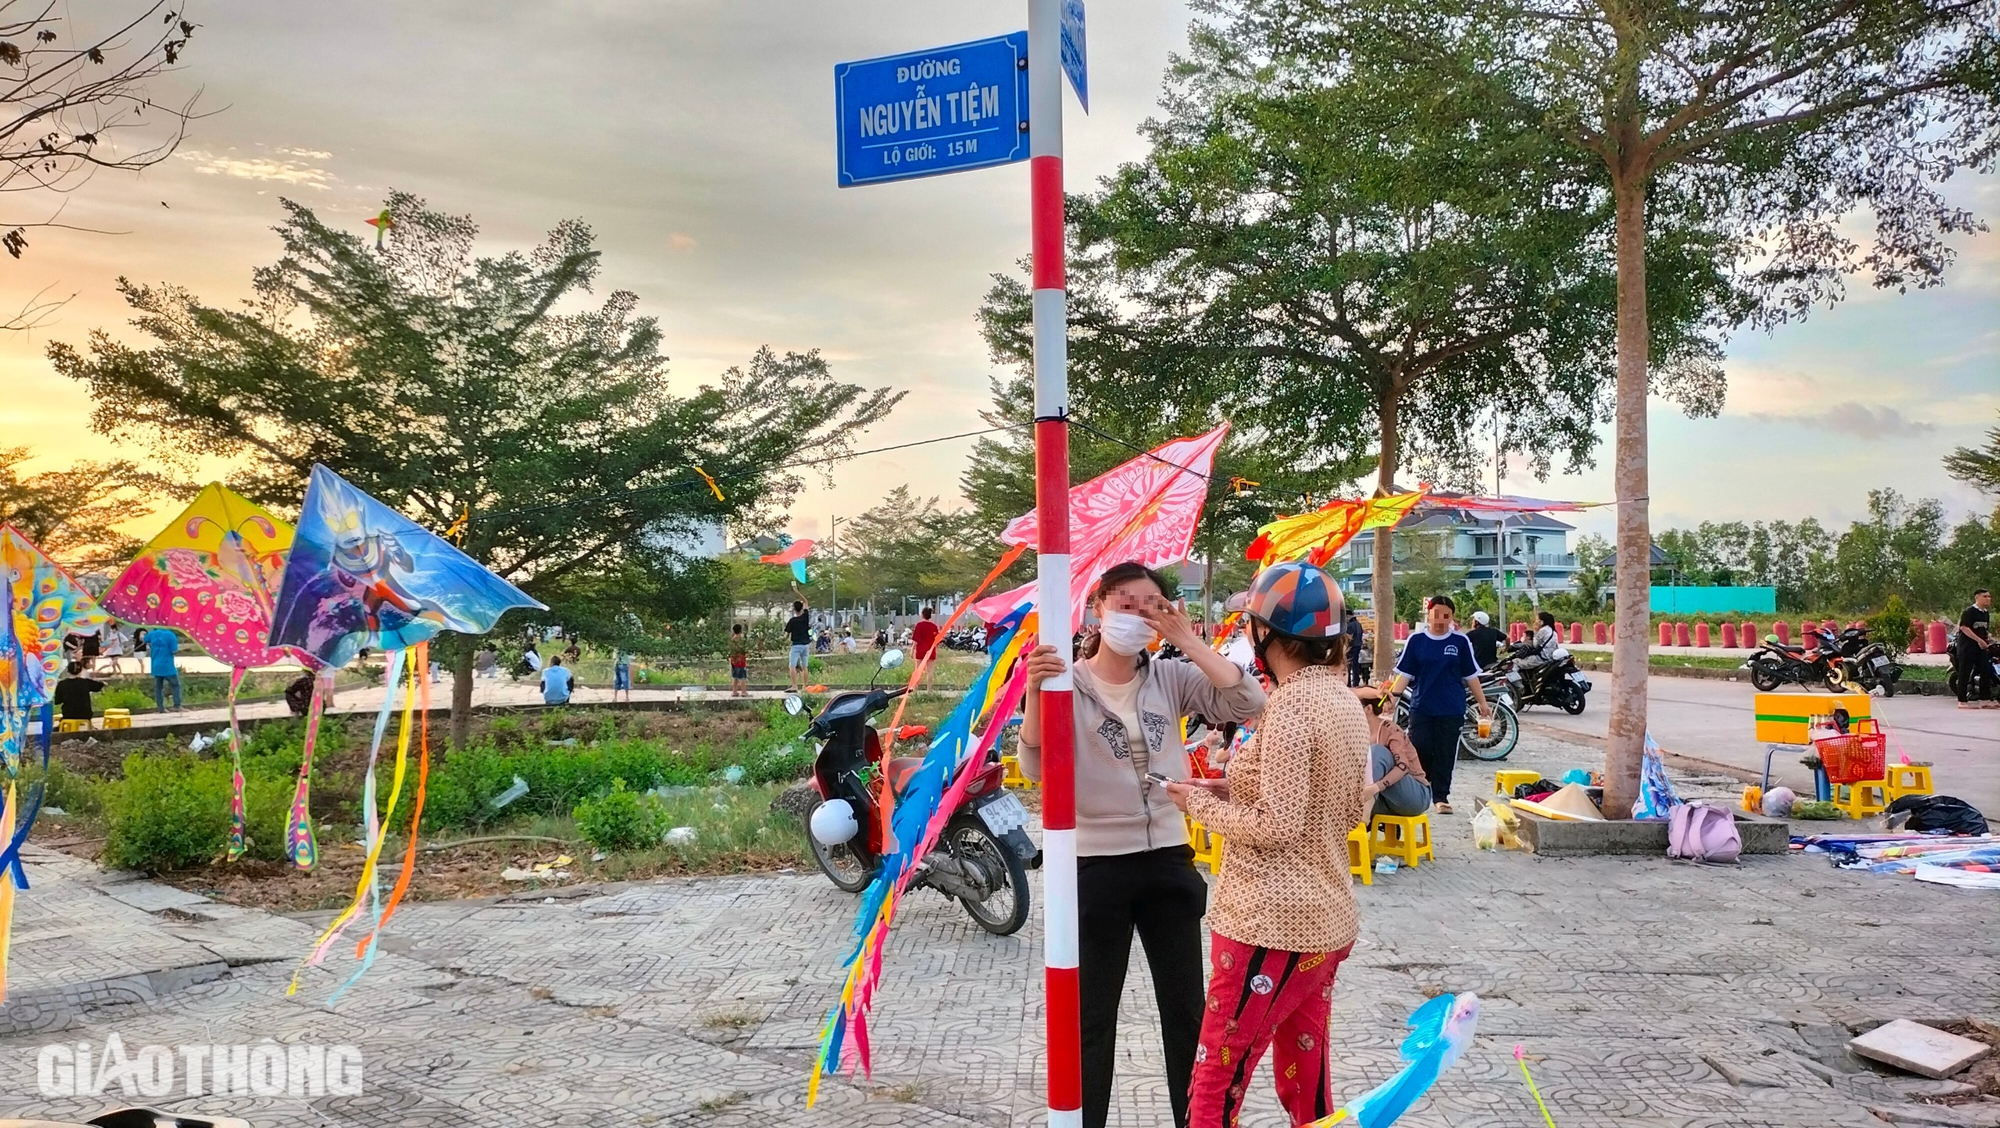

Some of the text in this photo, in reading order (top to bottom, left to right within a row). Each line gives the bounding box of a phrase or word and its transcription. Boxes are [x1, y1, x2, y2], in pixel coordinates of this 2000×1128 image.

[897, 58, 961, 83] ĐƯỜNG
[860, 83, 999, 138] NGUYỄN TIỆM
[883, 147, 902, 166] LỘ
[905, 143, 937, 162] GIỚI:
[1300, 954, 1324, 970] GUCCI
